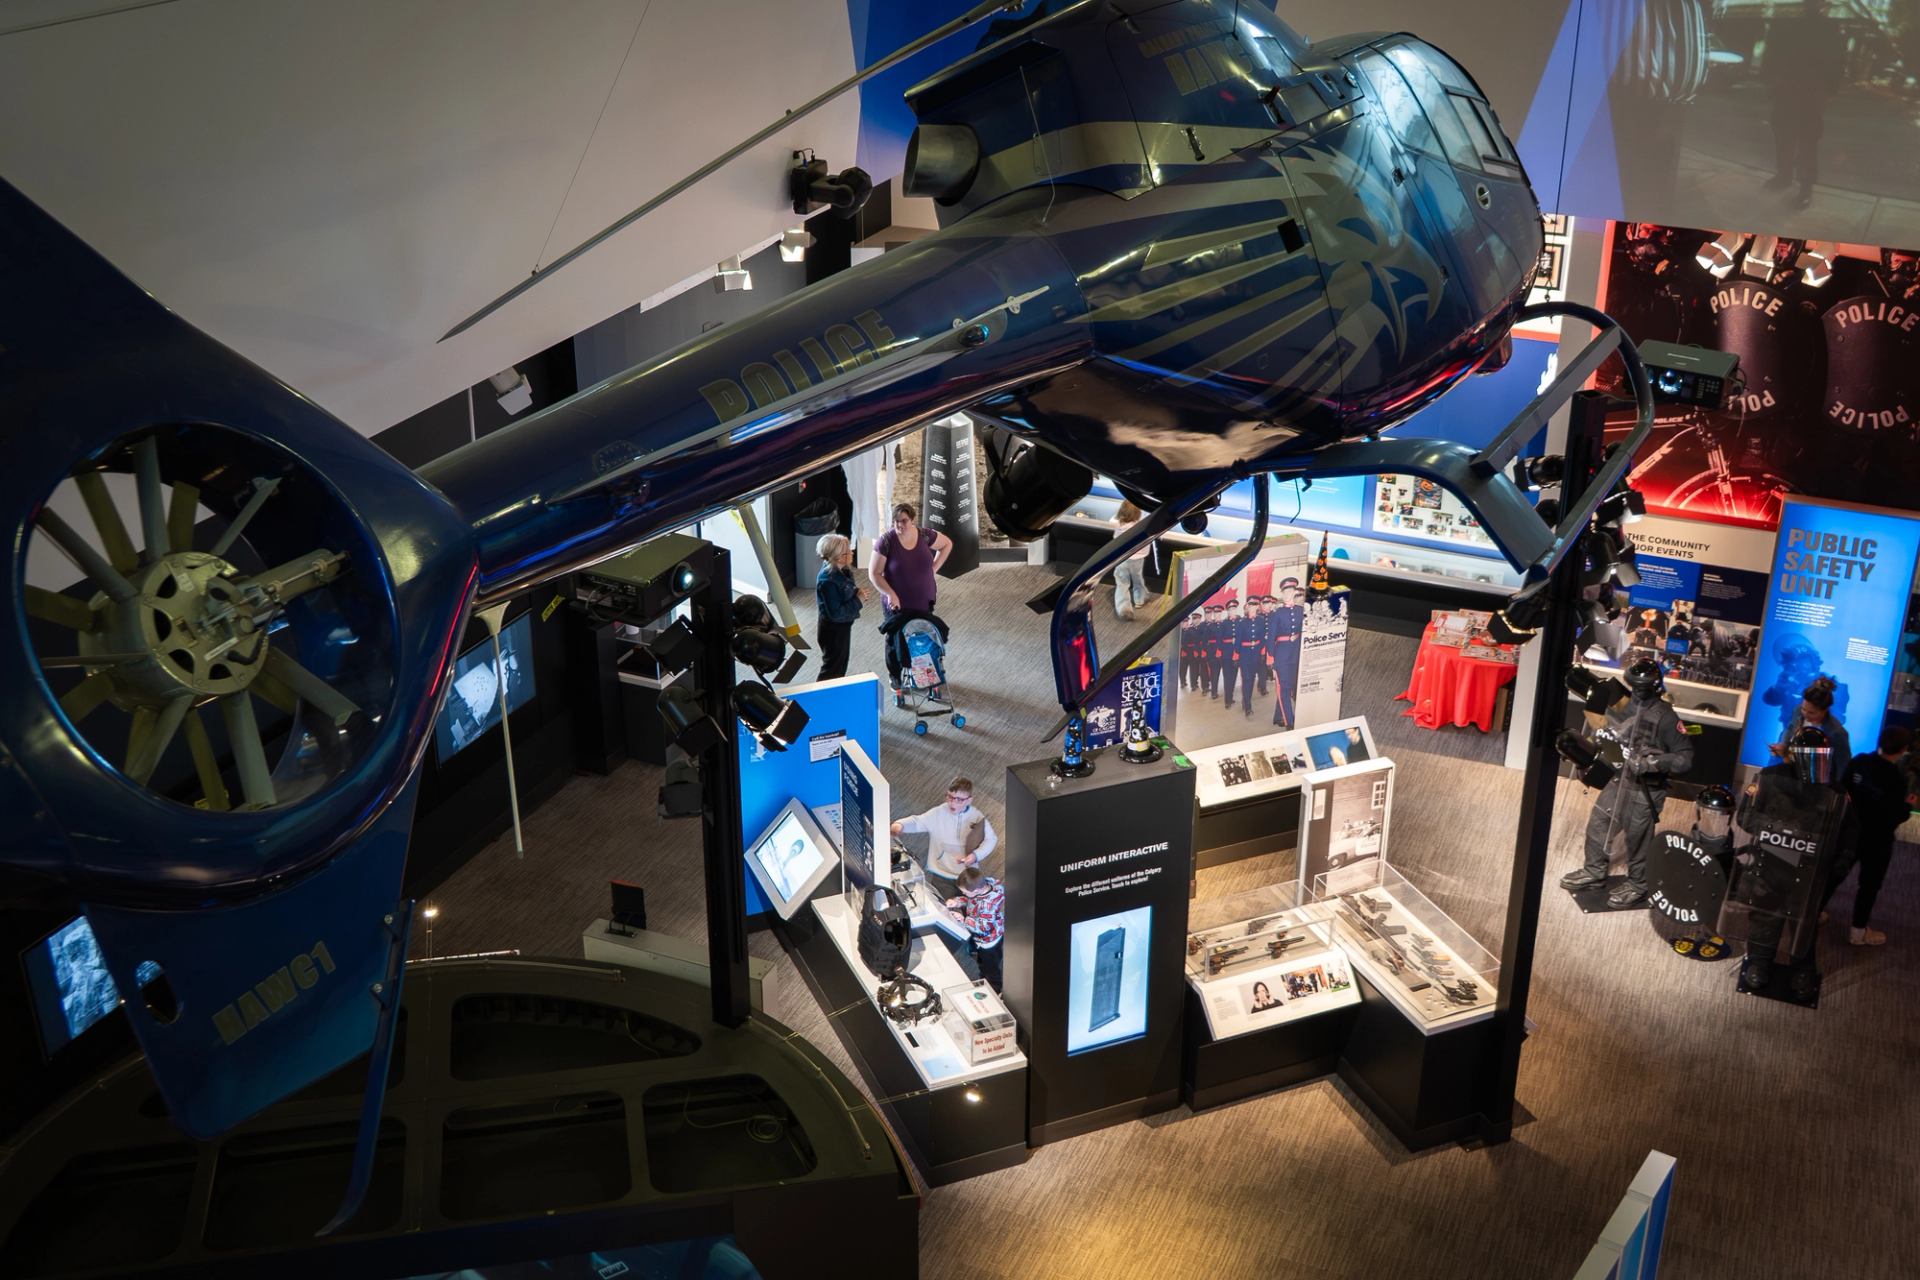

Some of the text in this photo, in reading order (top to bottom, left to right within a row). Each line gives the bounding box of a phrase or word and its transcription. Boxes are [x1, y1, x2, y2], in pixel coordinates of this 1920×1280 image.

[1710, 287, 1784, 317] POLICE
[1834, 302, 1920, 332] POLICE
[698, 309, 897, 424] POLICE
[1828, 400, 1910, 430] POLICE
[1627, 532, 1711, 552] THE COMMUNITY
[1634, 543, 1694, 559] JOR EVENTS
[1787, 528, 1878, 560] PUBLIC
[1783, 551, 1876, 583] SAFETY
[1780, 573, 1840, 600] UNIT
[1304, 635, 1327, 644] Police
[1666, 834, 1712, 866] POLICE
[1759, 830, 1817, 854] POLICE
[1060, 842, 1168, 873] UNIFORM INTERACTIVE
[1078, 889, 1092, 897] Police
[1652, 890, 1699, 922] POLICE
[211, 940, 337, 1046] HAWC1
